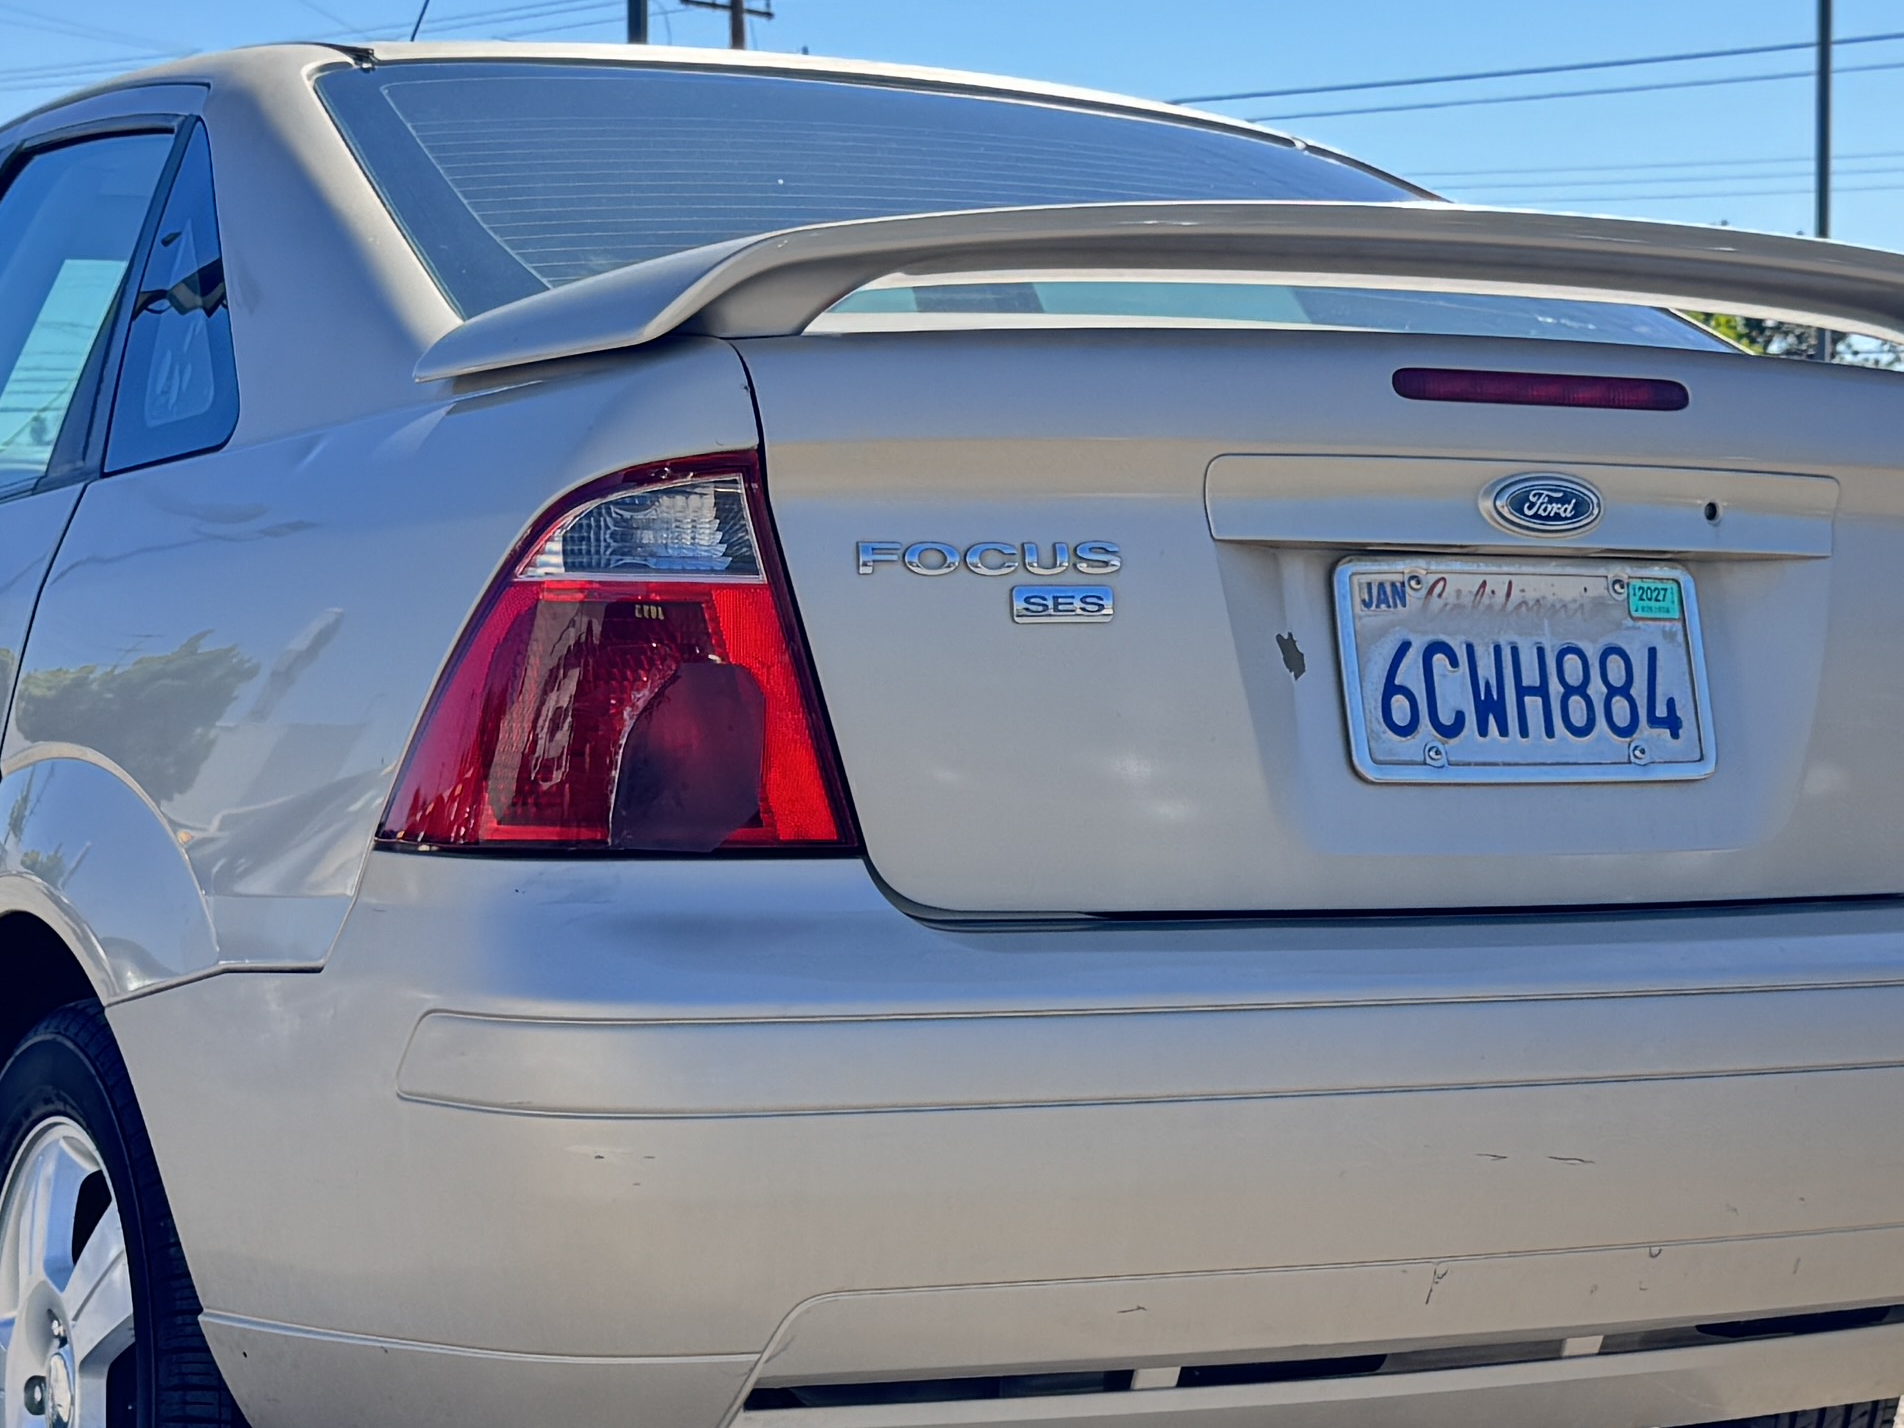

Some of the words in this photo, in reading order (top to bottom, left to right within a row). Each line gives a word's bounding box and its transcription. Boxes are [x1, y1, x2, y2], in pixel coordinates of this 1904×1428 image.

[1523, 489, 1577, 518] Ford
[855, 539, 1123, 576] FOCUS
[1022, 594, 1106, 614] SES
[1360, 580, 1408, 611] JAN
[1637, 585, 1668, 603] 2027
[1380, 640, 1684, 740] 6CWH884
